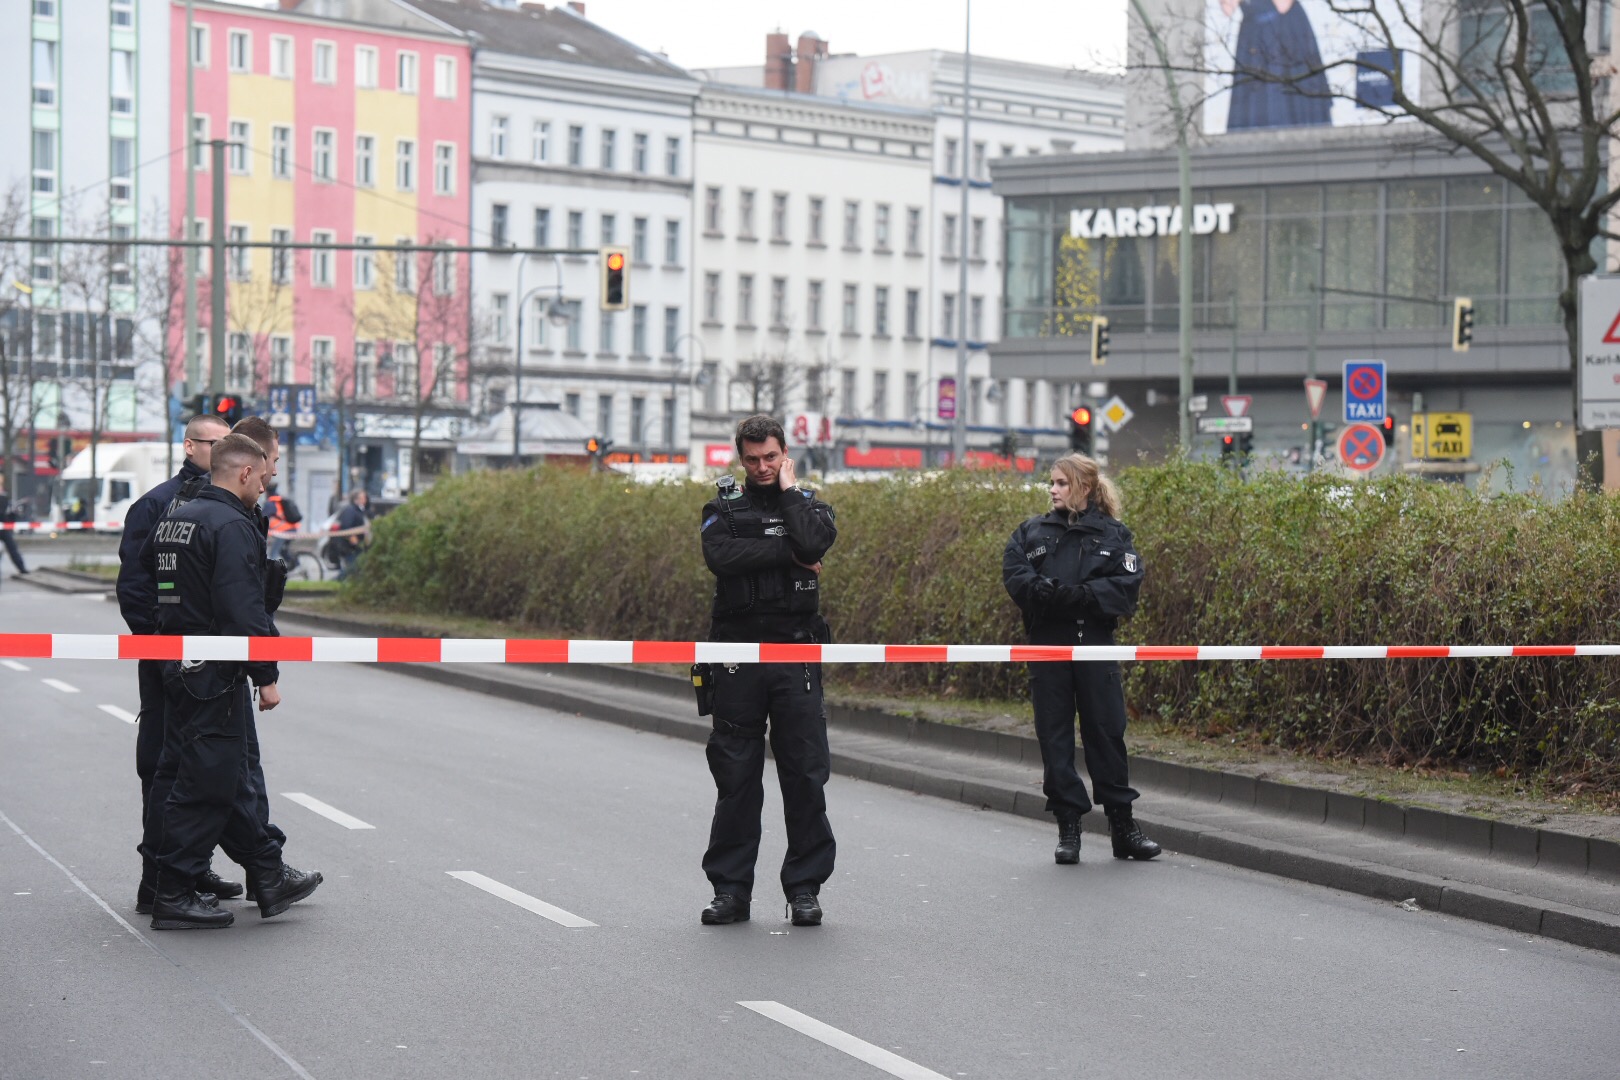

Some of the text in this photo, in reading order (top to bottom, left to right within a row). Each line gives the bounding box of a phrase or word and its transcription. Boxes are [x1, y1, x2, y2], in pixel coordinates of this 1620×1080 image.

[1070, 203, 1235, 239] KARSTADT
[1348, 403, 1382, 418] TAXI
[1432, 441, 1463, 454] TAXI
[154, 520, 196, 544] POLIZEI
[1026, 545, 1047, 561] POLIZEI
[157, 552, 177, 571] 3512R
[795, 579, 816, 592] POZE
